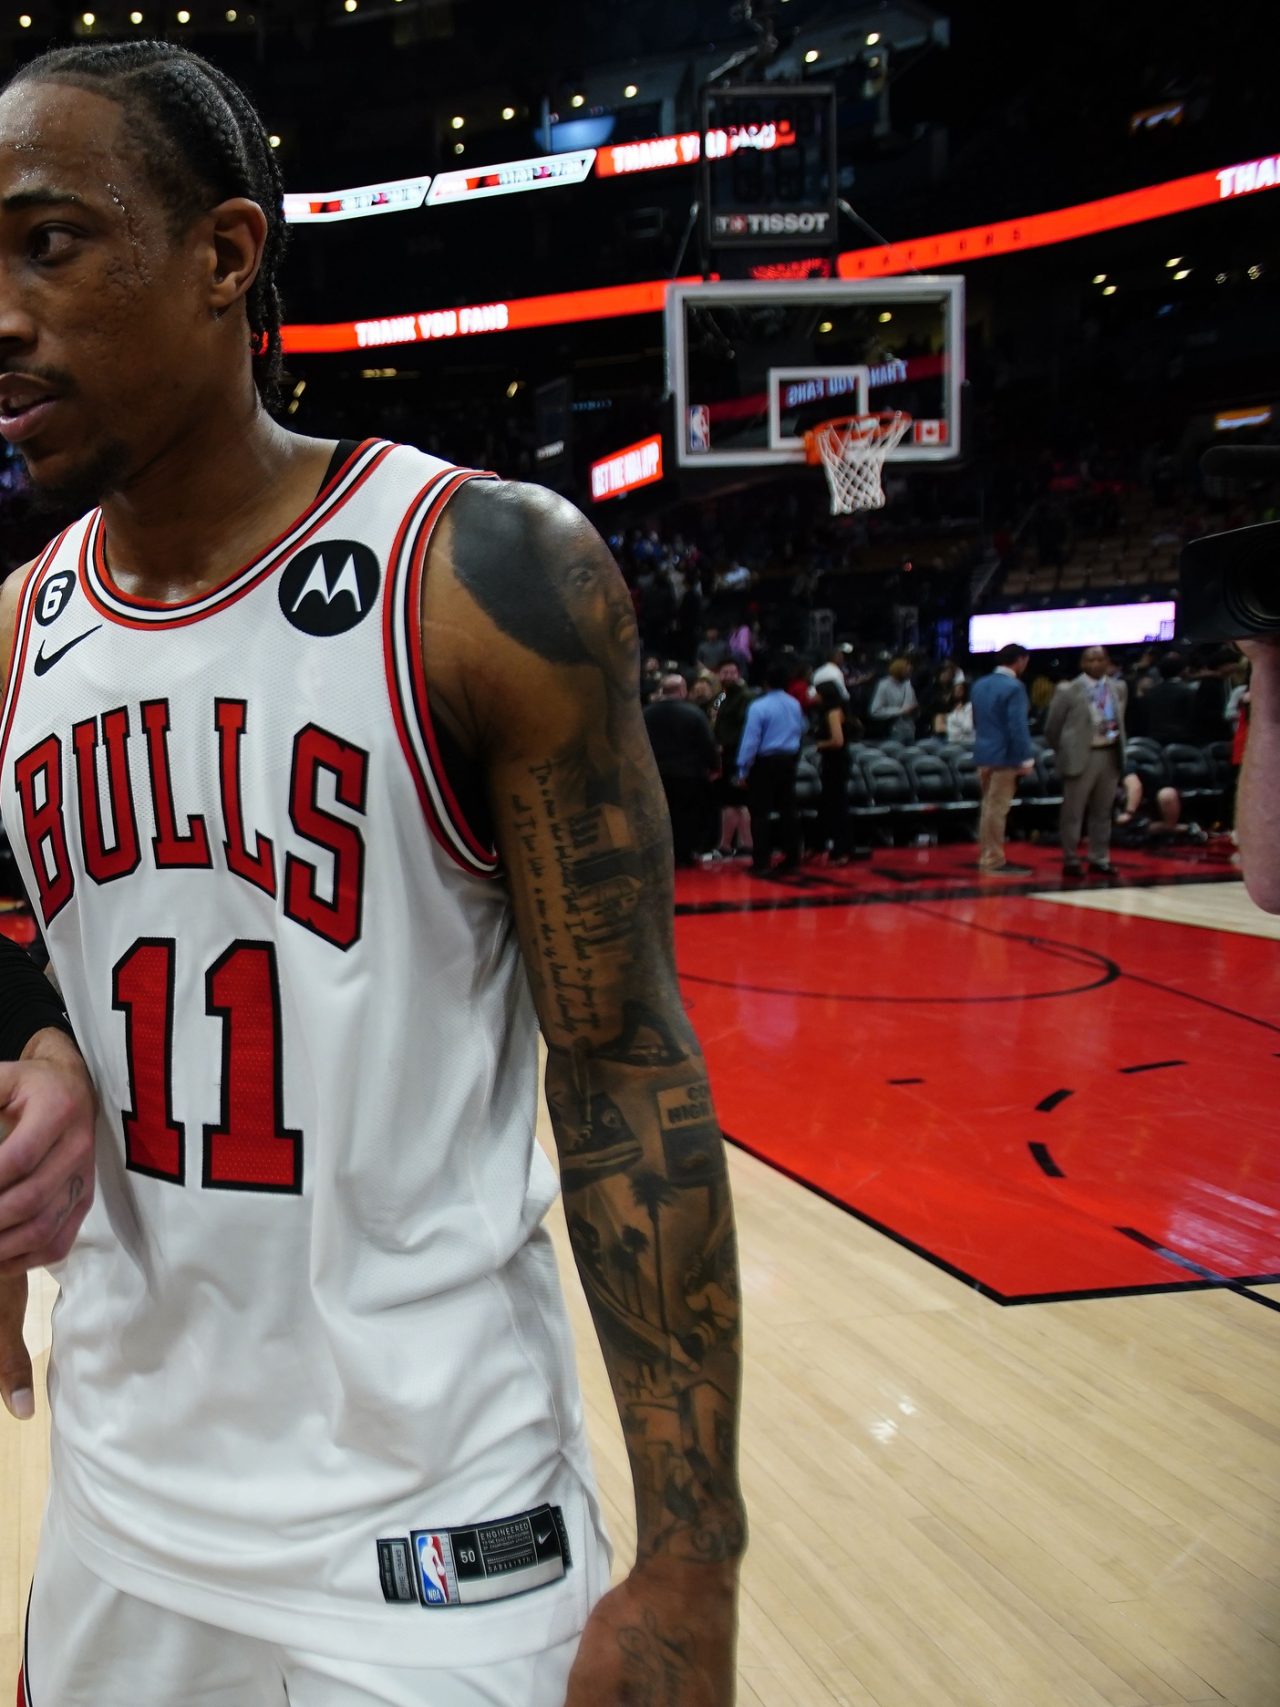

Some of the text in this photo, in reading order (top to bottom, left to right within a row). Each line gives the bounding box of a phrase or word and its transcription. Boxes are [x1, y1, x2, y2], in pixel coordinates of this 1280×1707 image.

[611, 138, 677, 173] THANK
[748, 212, 829, 234] TISSOT
[355, 303, 509, 348] THANK YOU FANS
[42, 575, 69, 619] 6
[14, 697, 370, 952] BULLS
[112, 937, 304, 1195] 11
[480, 1522, 529, 1540] ENGINEERED
[460, 1550, 476, 1564] 50
[428, 1588, 441, 1601] NBA
